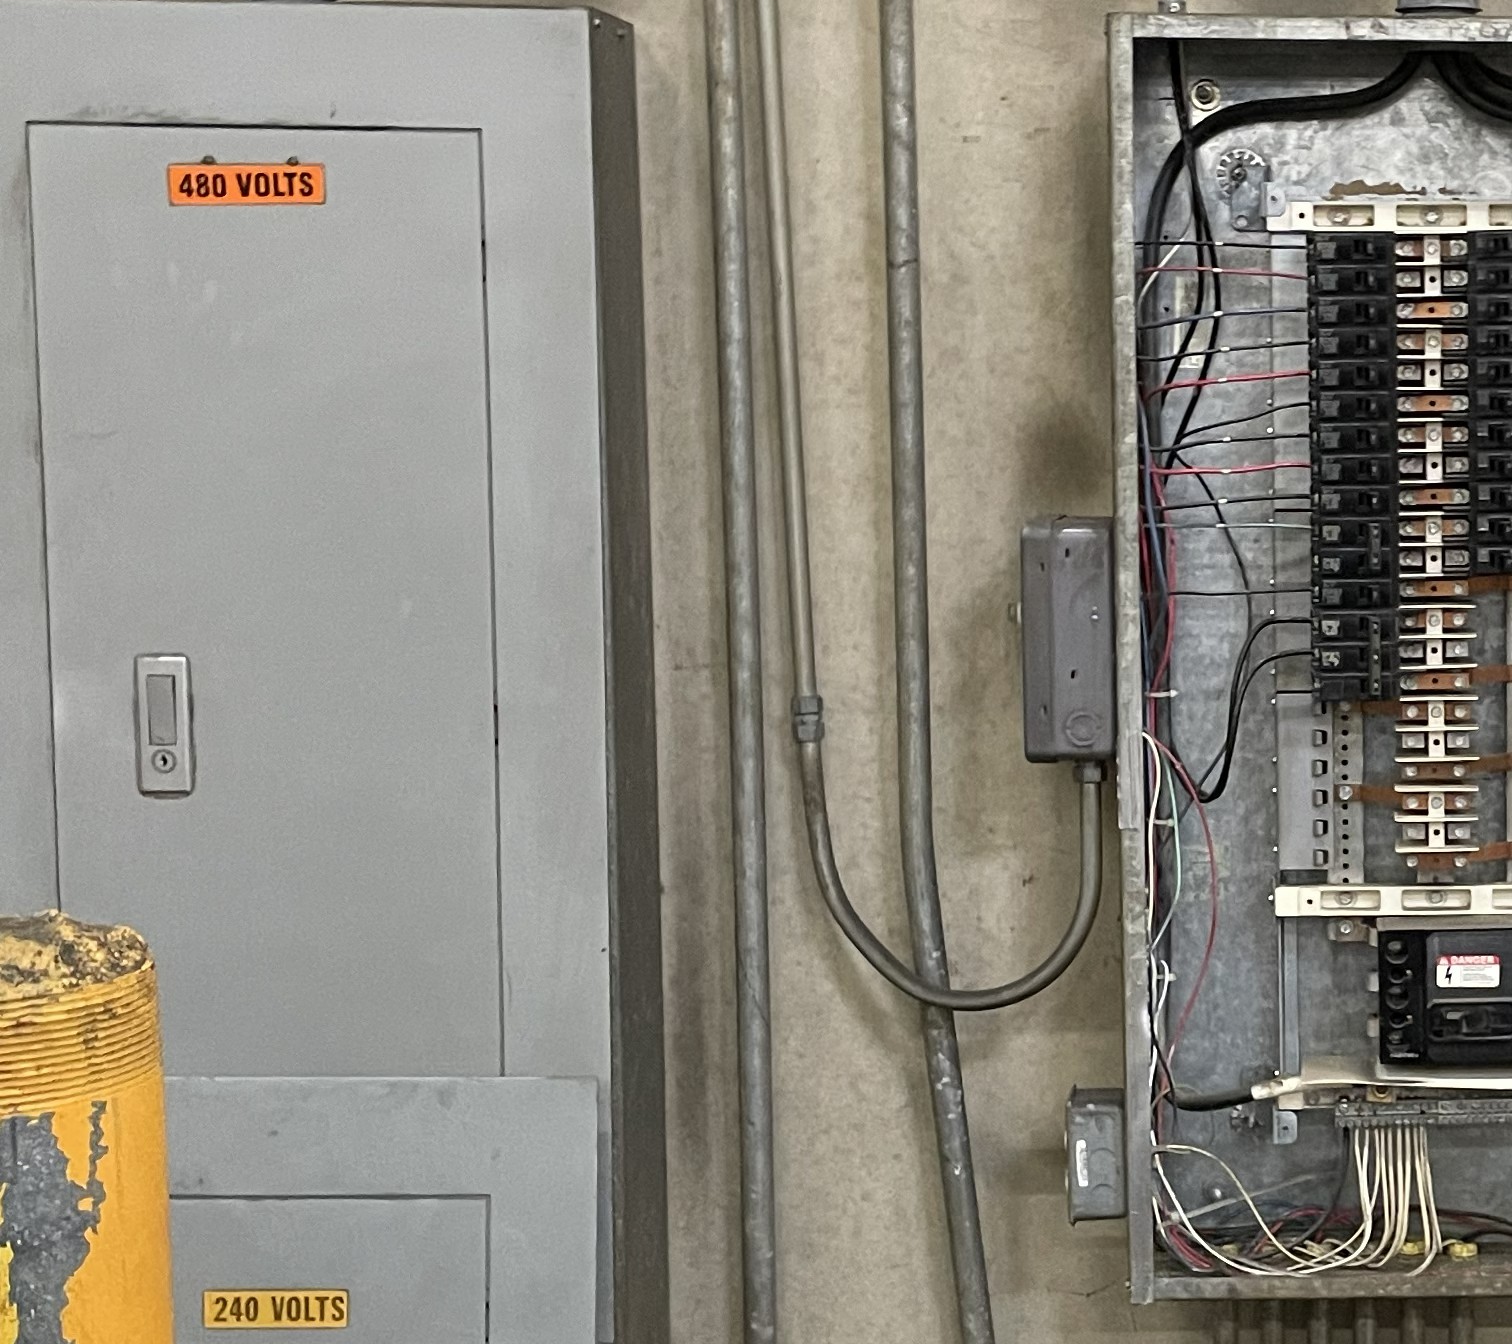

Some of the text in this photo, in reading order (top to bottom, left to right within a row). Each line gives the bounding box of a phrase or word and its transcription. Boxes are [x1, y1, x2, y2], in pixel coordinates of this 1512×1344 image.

[179, 172, 314, 197] 480 VOLTS
[1450, 955, 1494, 965] DANGER
[213, 1296, 345, 1322] 240 VOLTS
